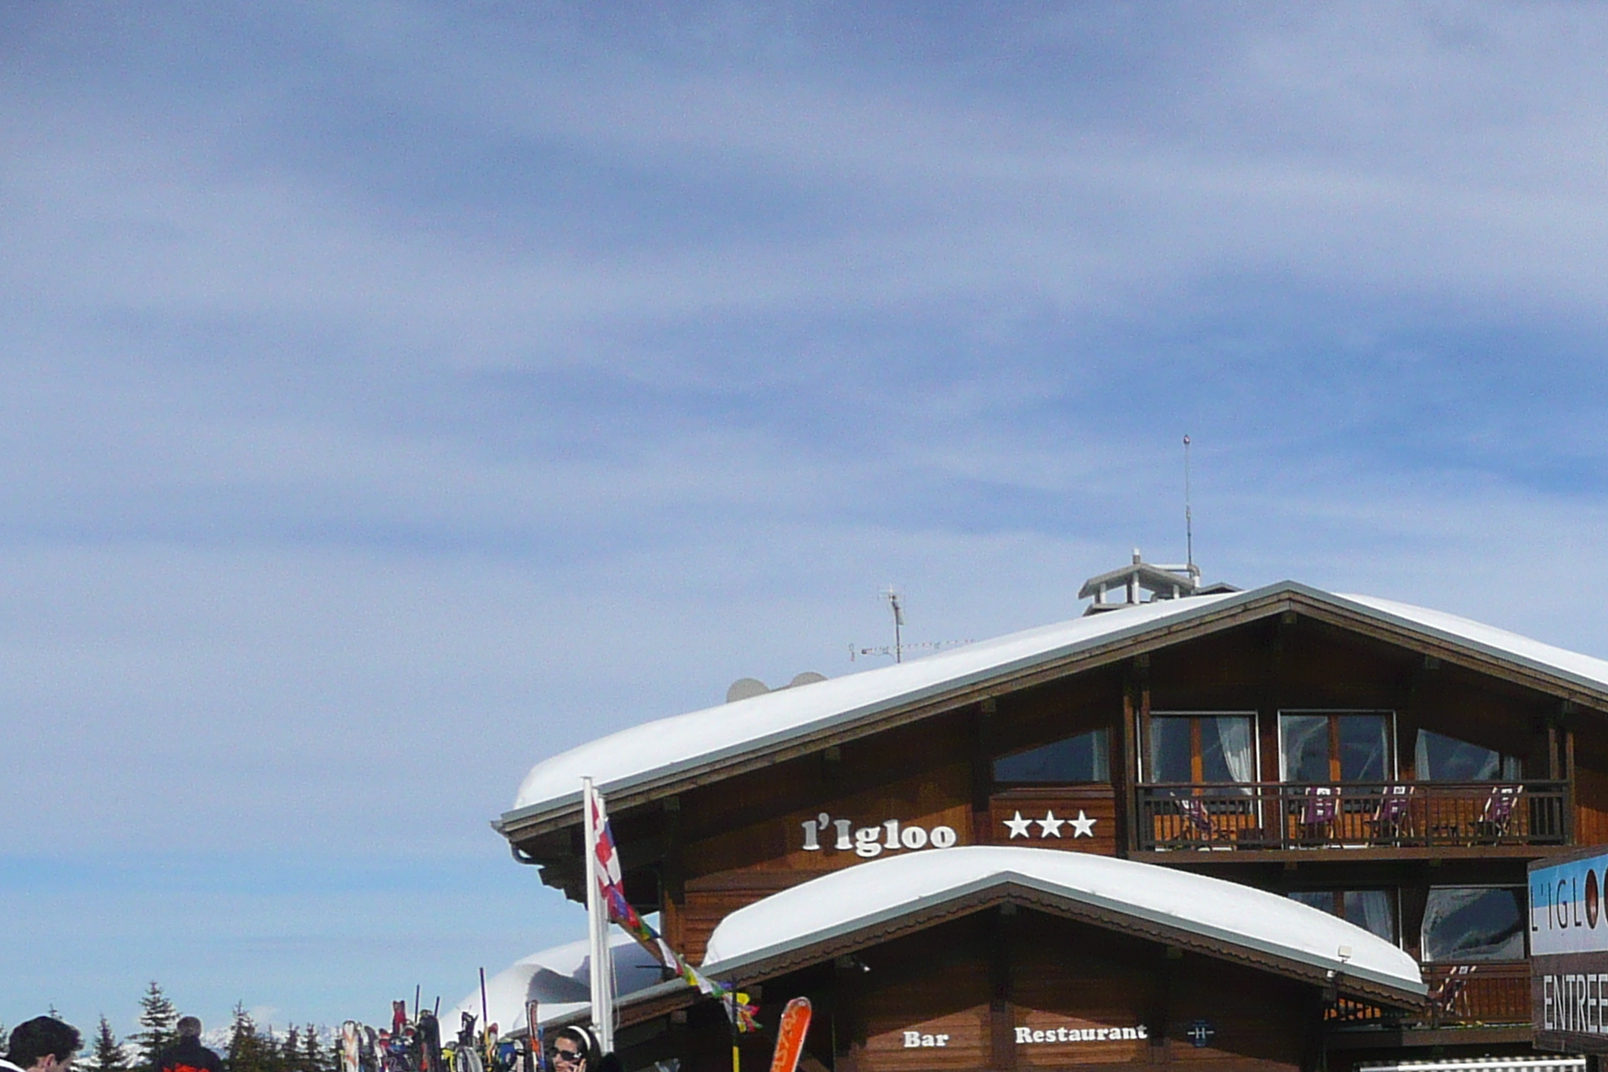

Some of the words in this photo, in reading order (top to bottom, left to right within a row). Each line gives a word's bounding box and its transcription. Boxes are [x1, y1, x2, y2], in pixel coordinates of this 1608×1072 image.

[801, 812, 957, 858] l'Igloo
[903, 1031, 949, 1048] Bar
[1014, 1024, 1148, 1044] Restaurant
